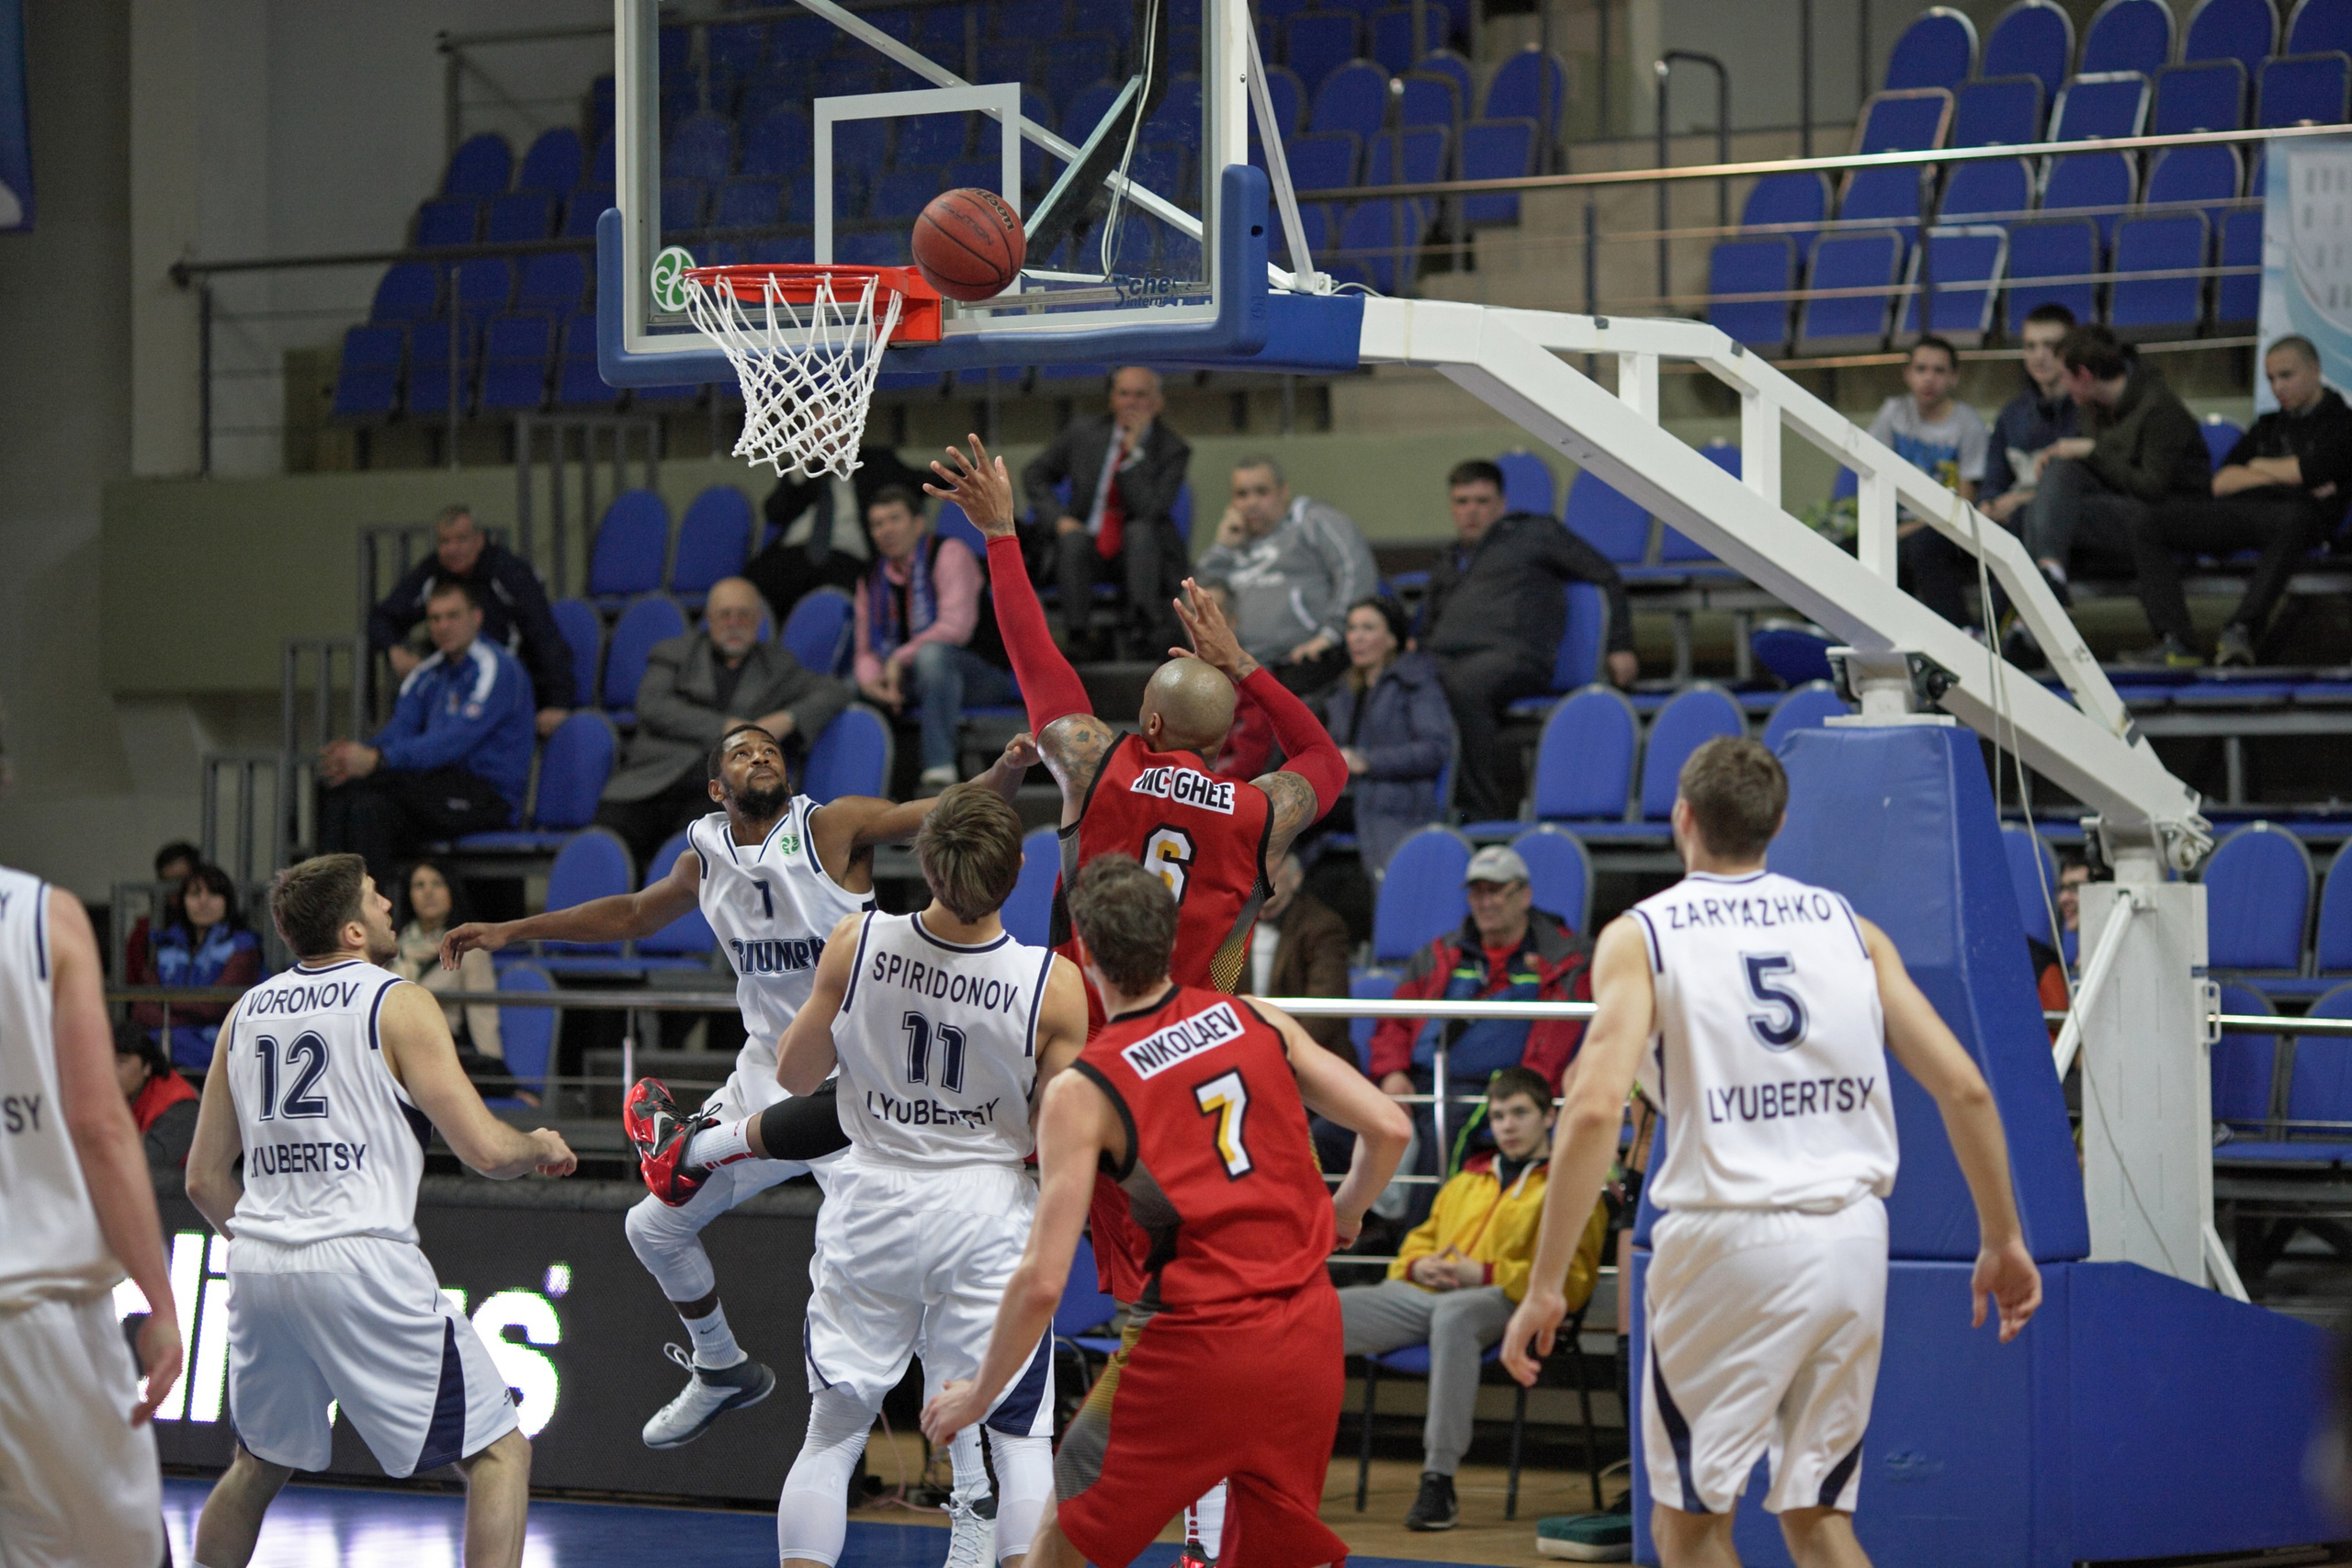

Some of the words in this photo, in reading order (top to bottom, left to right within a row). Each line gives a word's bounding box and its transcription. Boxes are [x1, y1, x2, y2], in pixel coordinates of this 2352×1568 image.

[1140, 822, 1198, 908] 6
[1666, 893, 1831, 930] ZARYAZHKO
[729, 935, 828, 976] RIUMPH
[873, 951, 1019, 1014] SPIRIDONOV
[246, 981, 360, 1017] VORONOV
[1738, 951, 1810, 1054] 5
[901, 1010, 967, 1094] 11
[1128, 1006, 1239, 1074] NIKOLAEV
[254, 1030, 330, 1122] 12
[1707, 1077, 1875, 1123] LYUBERTSY
[1191, 1066, 1256, 1182] 7
[251, 1142, 367, 1179] YUBERTSY
